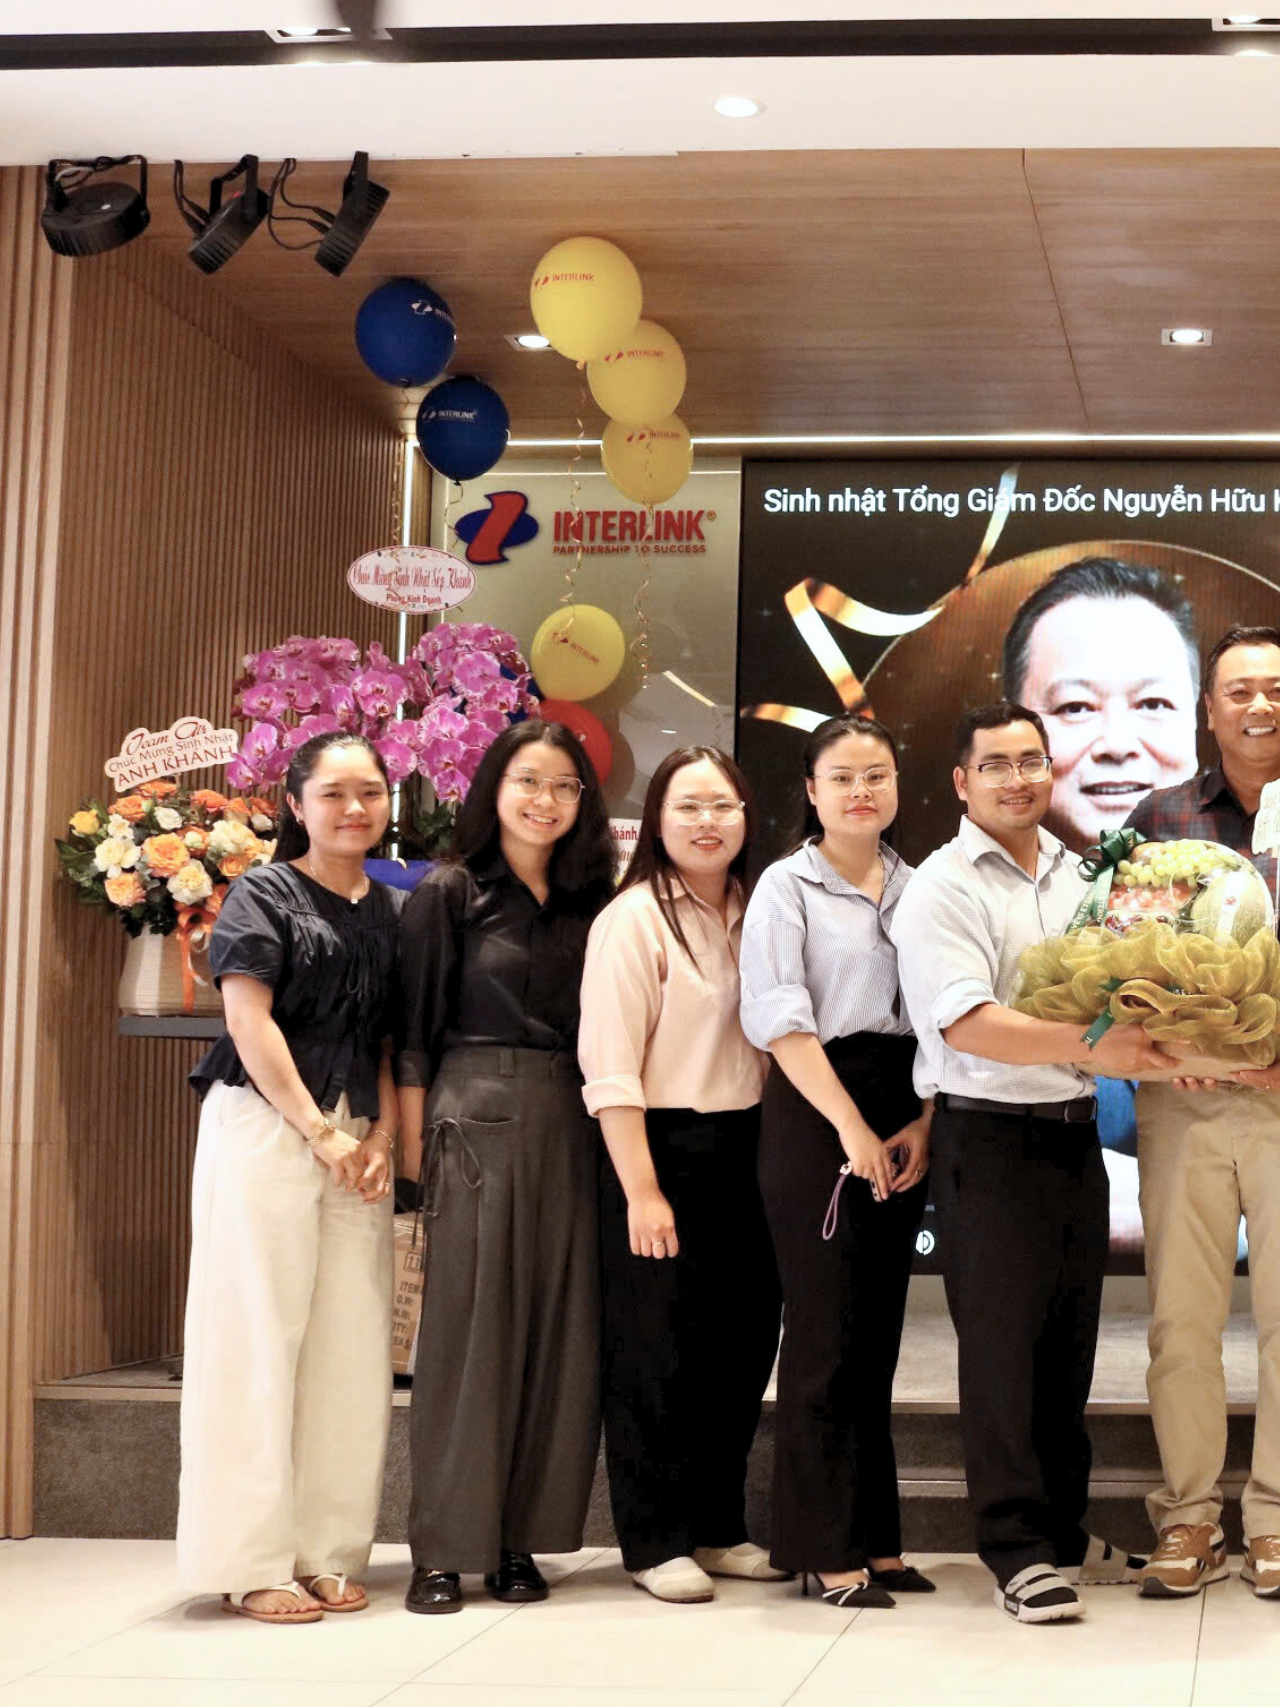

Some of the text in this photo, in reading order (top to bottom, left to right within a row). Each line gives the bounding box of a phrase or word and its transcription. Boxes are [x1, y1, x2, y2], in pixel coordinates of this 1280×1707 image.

[764, 488, 821, 513] Sinh
[828, 487, 887, 517] nhật
[892, 484, 960, 518] Tổng
[967, 486, 1036, 513] Giám
[1043, 485, 1096, 513] Đốc
[1103, 484, 1202, 518] Nguyễn
[1211, 487, 1266, 513] Hữu
[553, 544, 631, 554] PARTNERSHIP
[654, 544, 706, 554] SUCCESS
[109, 757, 136, 773] Chúc
[177, 738, 201, 751] Sinh
[205, 733, 234, 746] Nhật
[126, 732, 168, 756] Team
[118, 745, 233, 787] ANH KHÁNH
